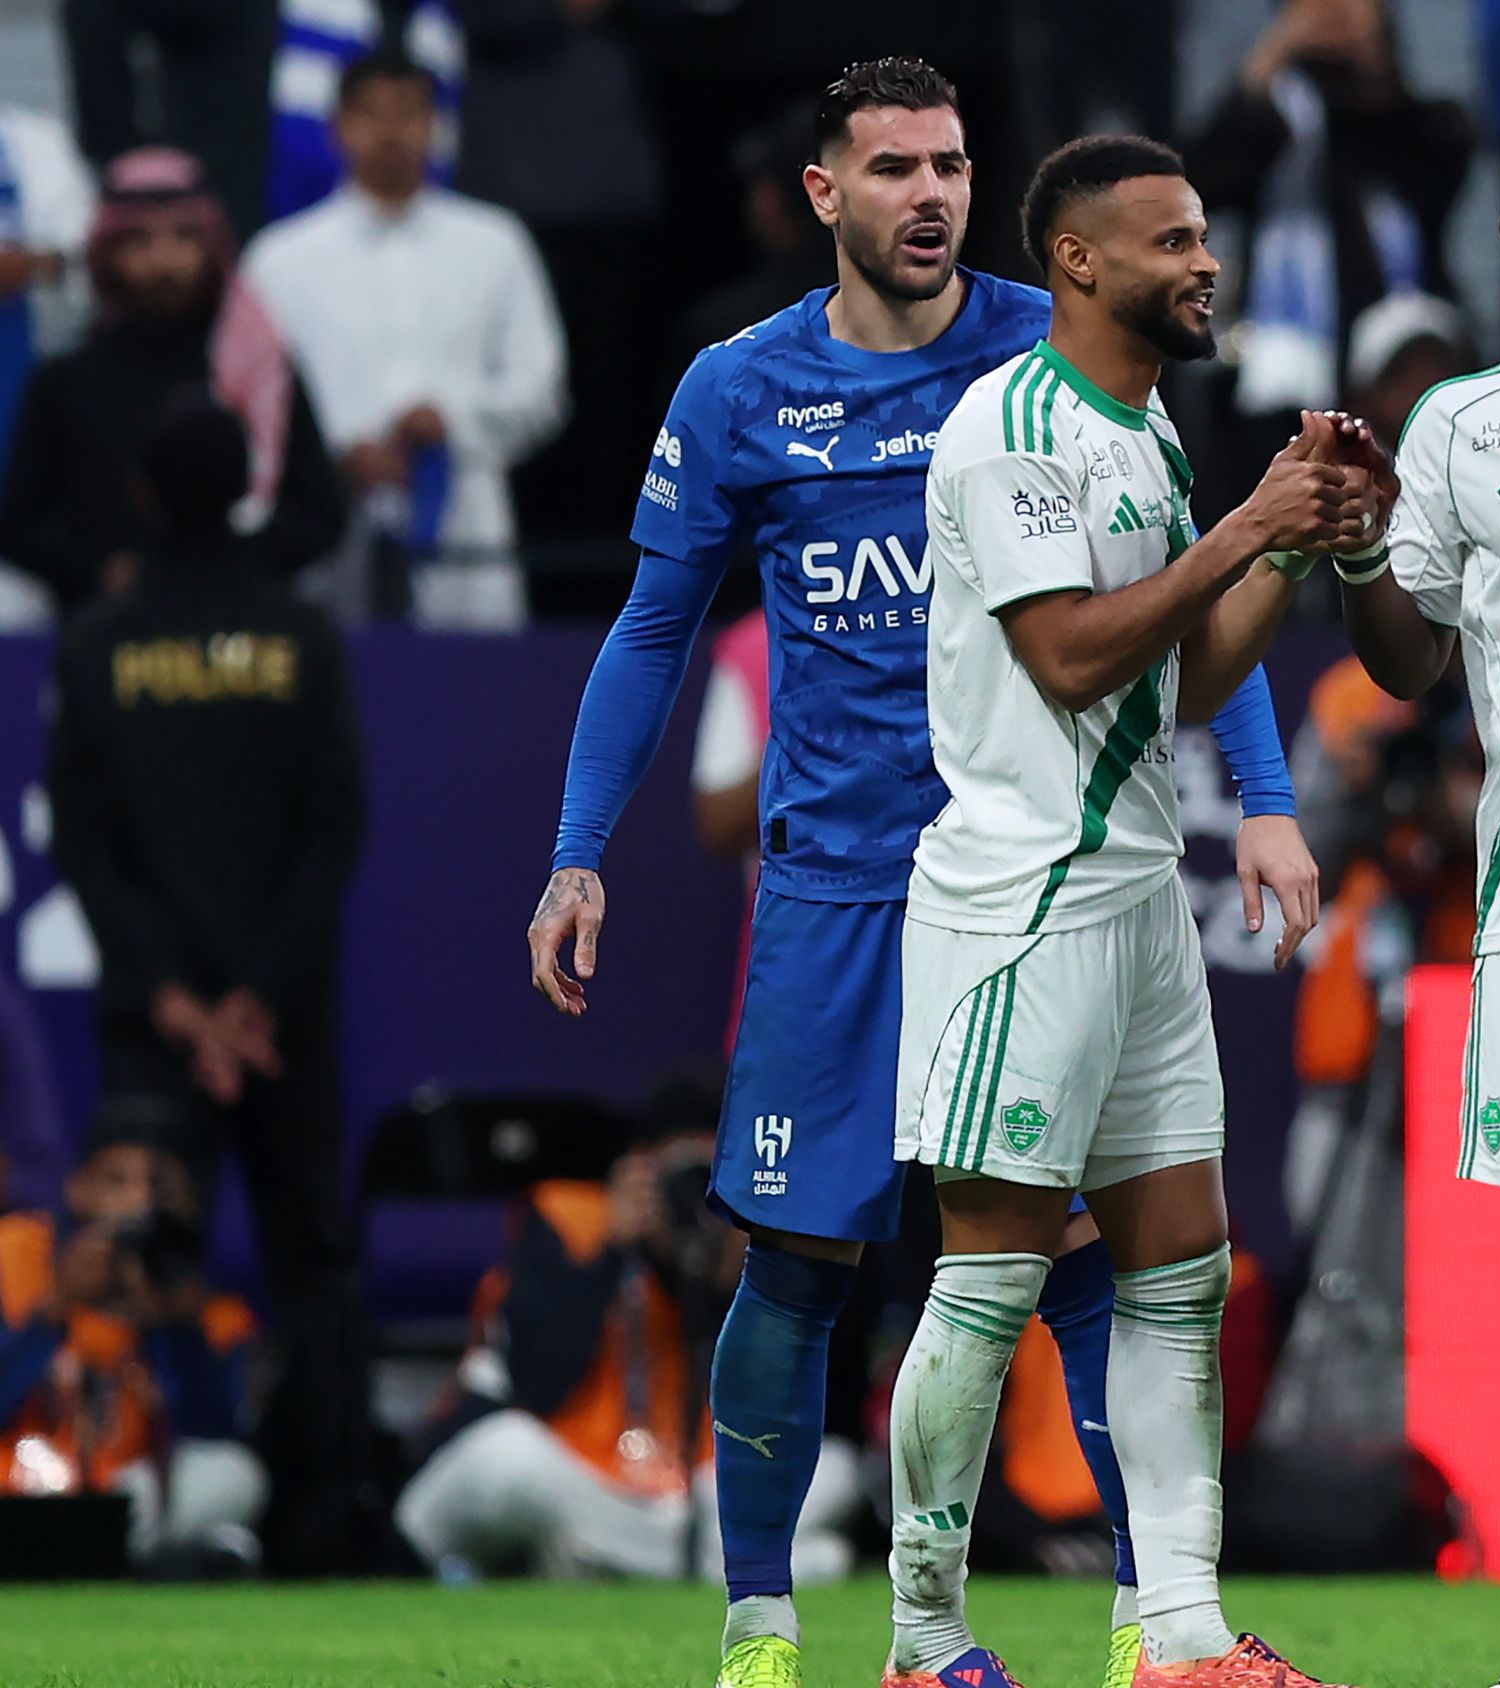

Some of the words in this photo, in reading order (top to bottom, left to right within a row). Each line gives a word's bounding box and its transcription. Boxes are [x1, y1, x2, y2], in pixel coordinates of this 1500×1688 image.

[777, 401, 845, 428] flynas
[1014, 495, 1070, 517] QAID
[814, 607, 927, 632] GAMES
